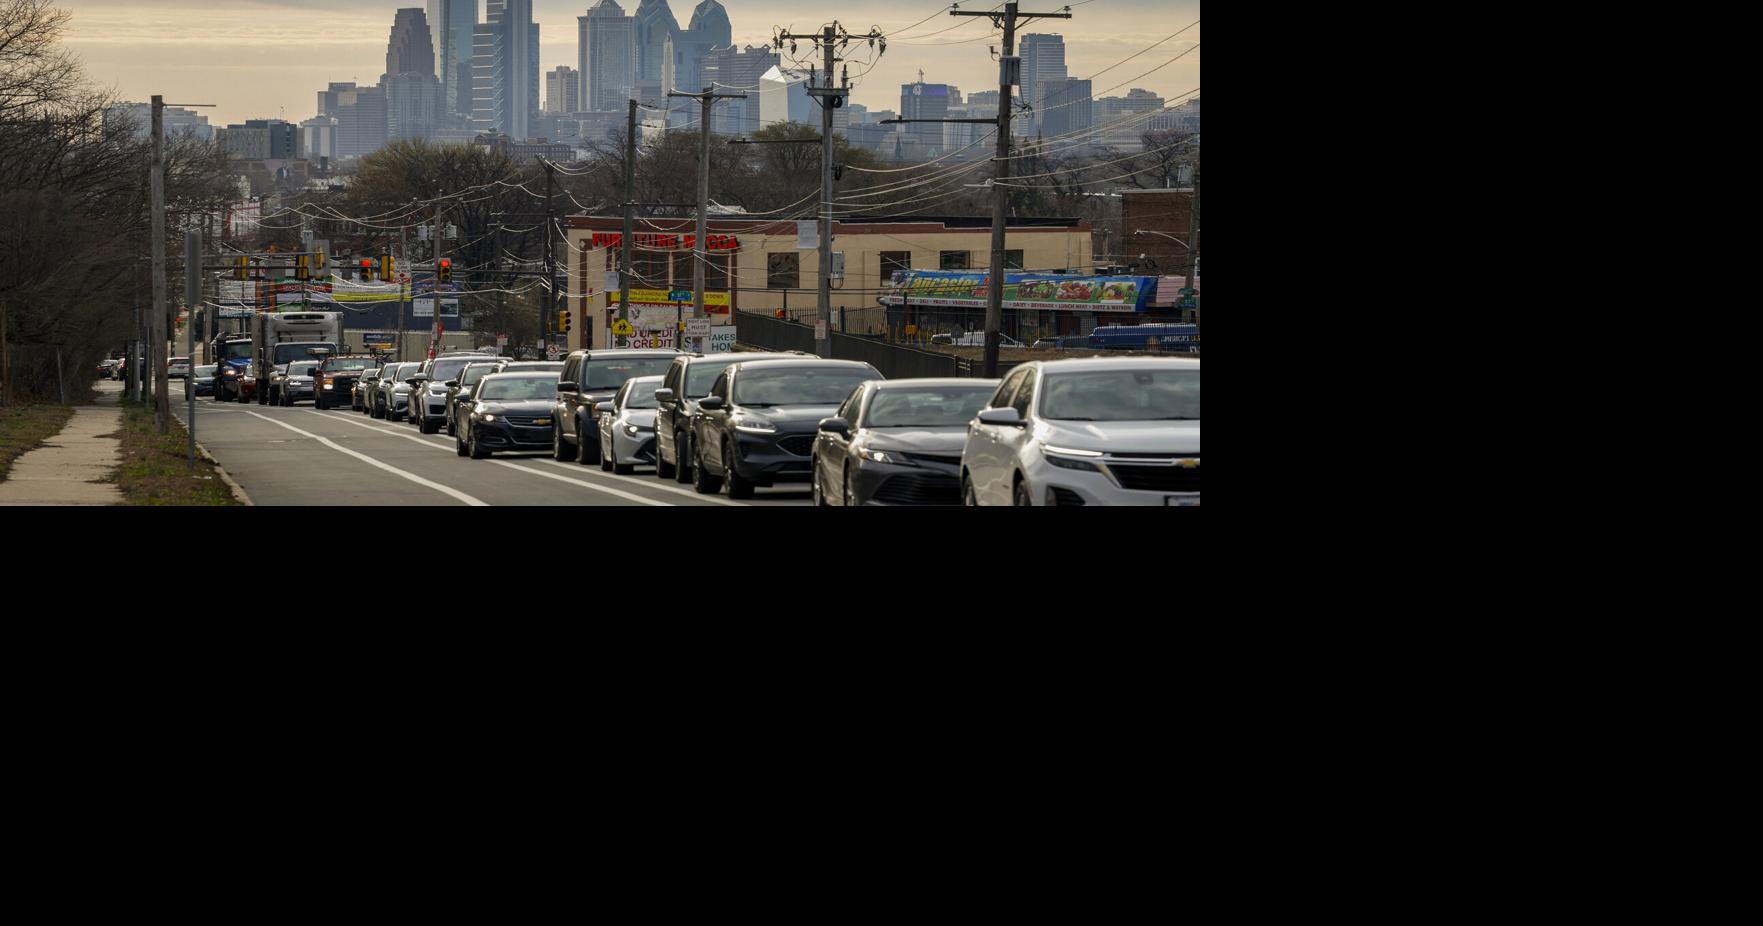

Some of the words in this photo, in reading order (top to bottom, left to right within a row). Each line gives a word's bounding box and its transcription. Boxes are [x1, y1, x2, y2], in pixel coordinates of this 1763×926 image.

[592, 233, 678, 249] FURITURE
[683, 234, 738, 251] MCCA
[633, 339, 673, 349] CREDIT
